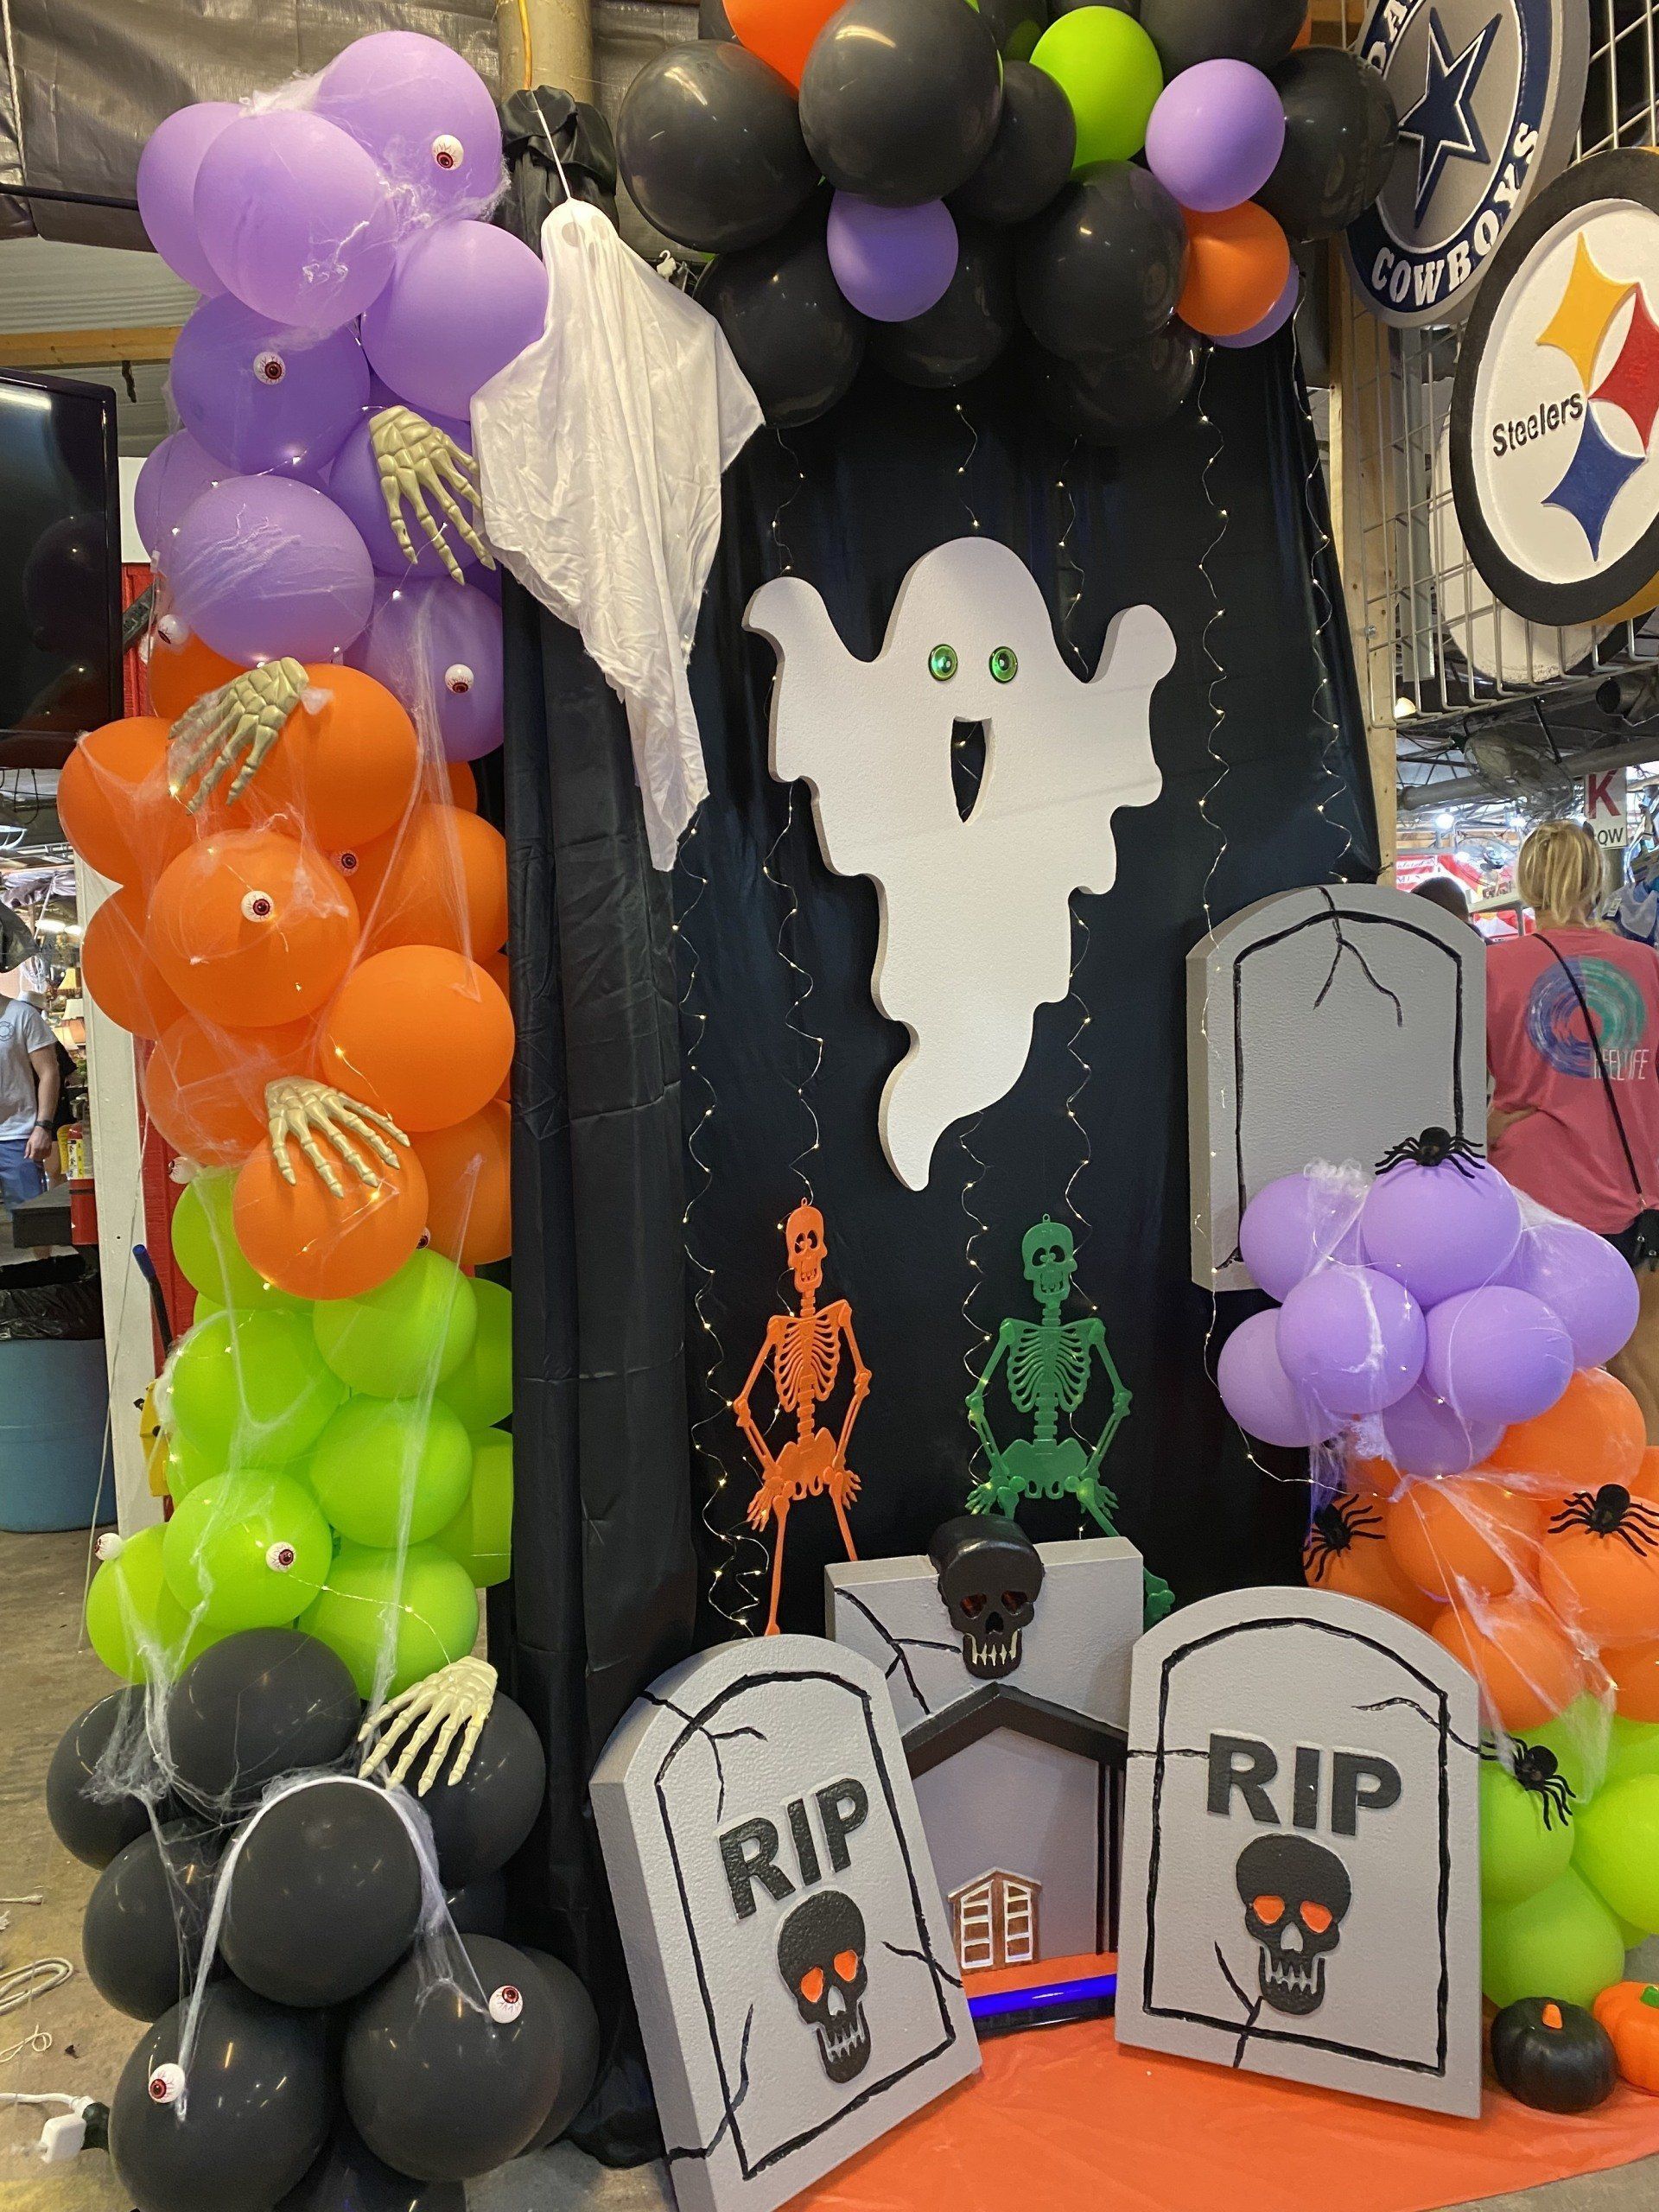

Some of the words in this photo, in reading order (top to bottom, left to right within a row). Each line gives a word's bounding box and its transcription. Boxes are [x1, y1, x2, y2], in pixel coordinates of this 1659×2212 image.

[1366, 0, 1416, 73] DA
[1371, 122, 1539, 306] COWBOYS
[1492, 393, 1583, 456] Steelers
[1588, 769, 1621, 819] K
[1593, 827, 1624, 846] OW
[1207, 1732, 1402, 1836] RIP
[719, 1777, 868, 1920] RIP
